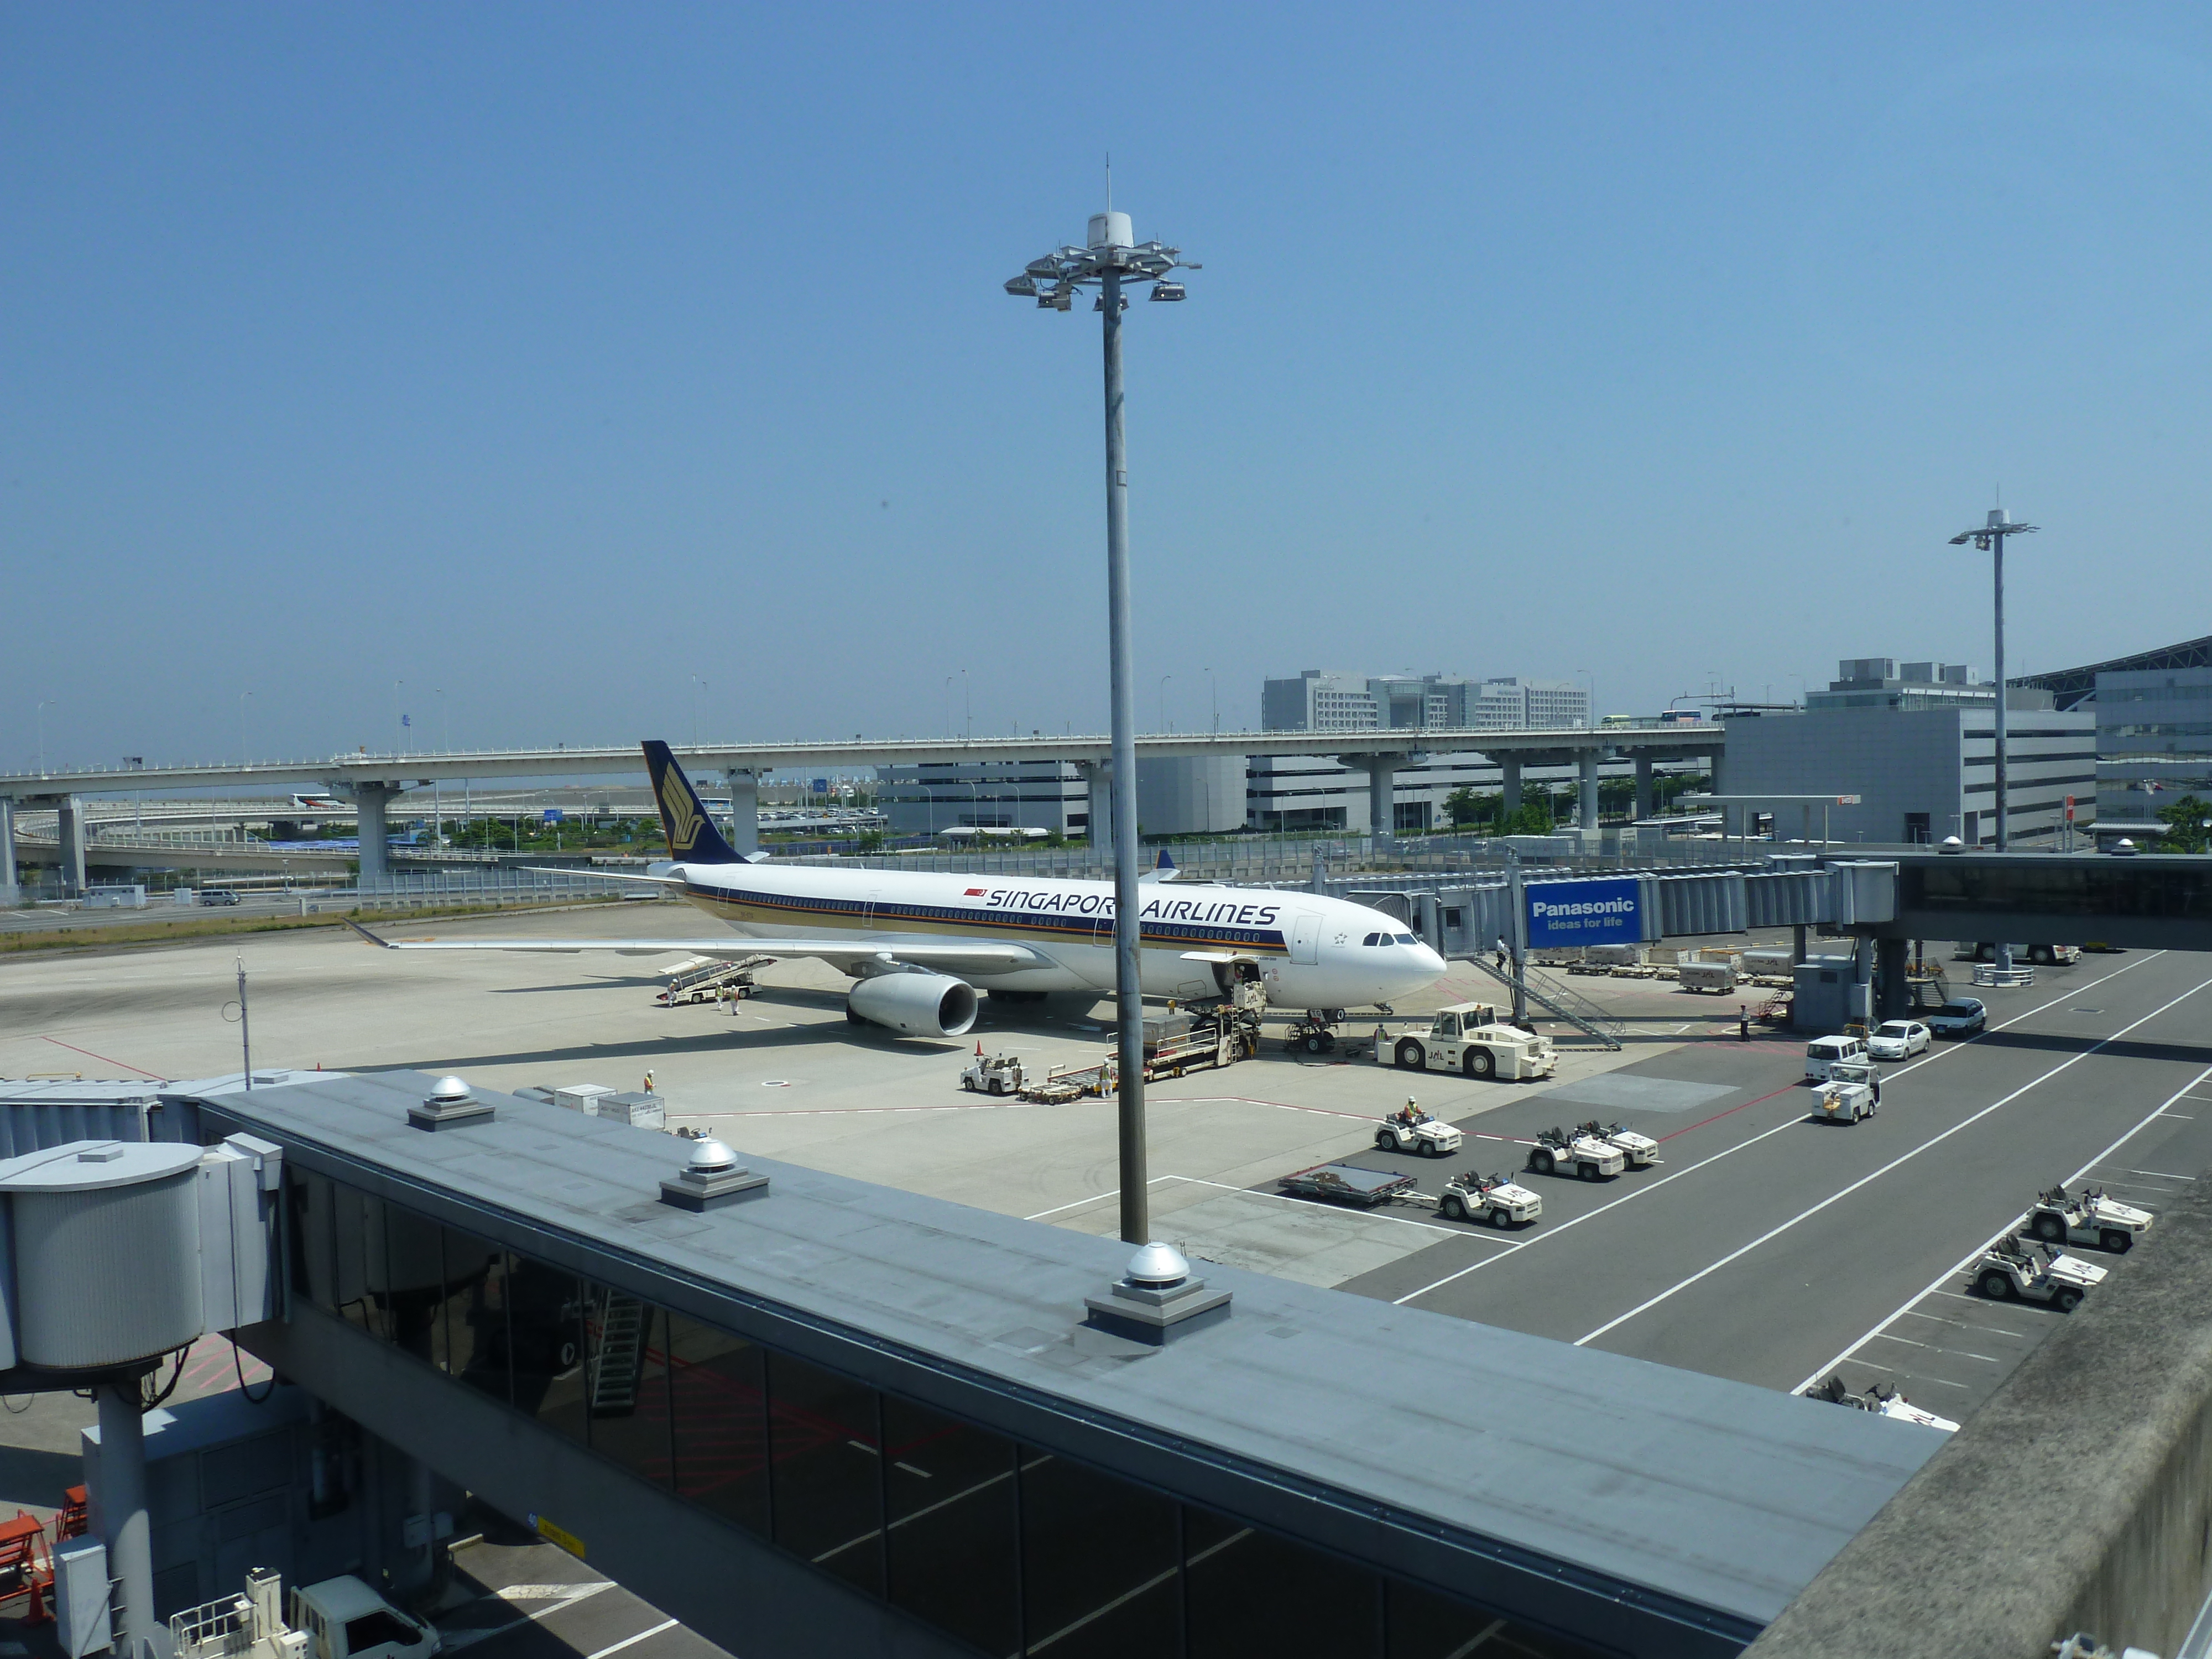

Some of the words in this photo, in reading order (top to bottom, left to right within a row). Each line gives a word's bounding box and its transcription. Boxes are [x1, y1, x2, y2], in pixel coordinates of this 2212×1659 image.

[986, 890, 1115, 916] SINGAPOR
[1140, 899, 1280, 926] AIRLINES
[1533, 897, 1634, 917] Panasonic
[1548, 920, 1581, 930] ideas
[1584, 918, 1601, 928] for
[1604, 916, 1623, 927] life
[1246, 993, 1258, 1005] JAL
[1428, 1050, 1444, 1062] JAL
